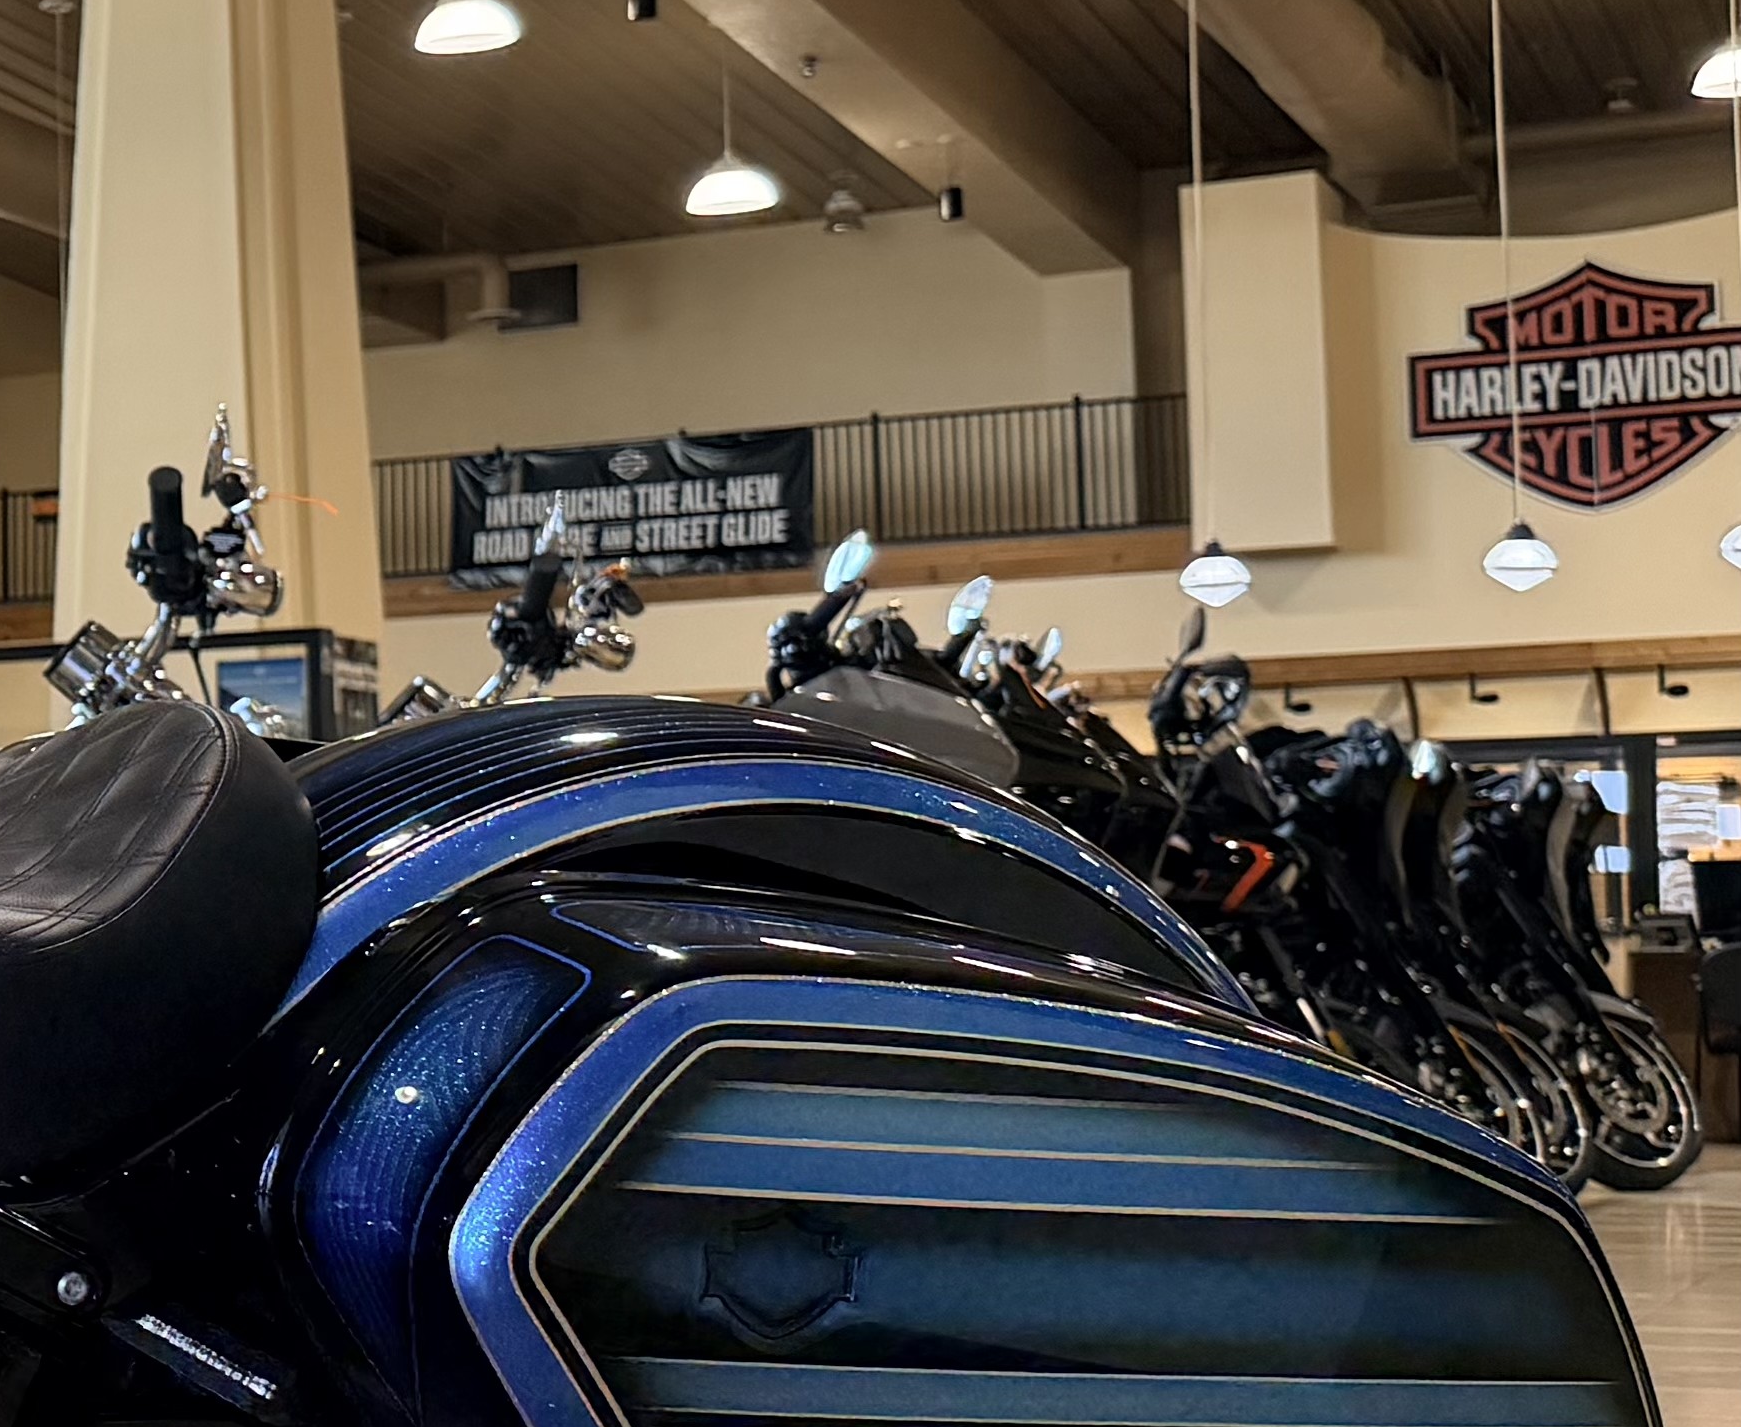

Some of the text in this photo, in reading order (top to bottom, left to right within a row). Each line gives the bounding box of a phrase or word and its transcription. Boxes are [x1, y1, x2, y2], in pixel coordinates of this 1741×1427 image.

[1508, 285, 1677, 347] MOTOR
[1509, 417, 1682, 488] CYCLES
[485, 472, 780, 529] INTROUCING THE ALL-NEW
[473, 528, 530, 565] ROAD
[635, 514, 718, 553] STREET
[720, 508, 789, 546] GLIDE
